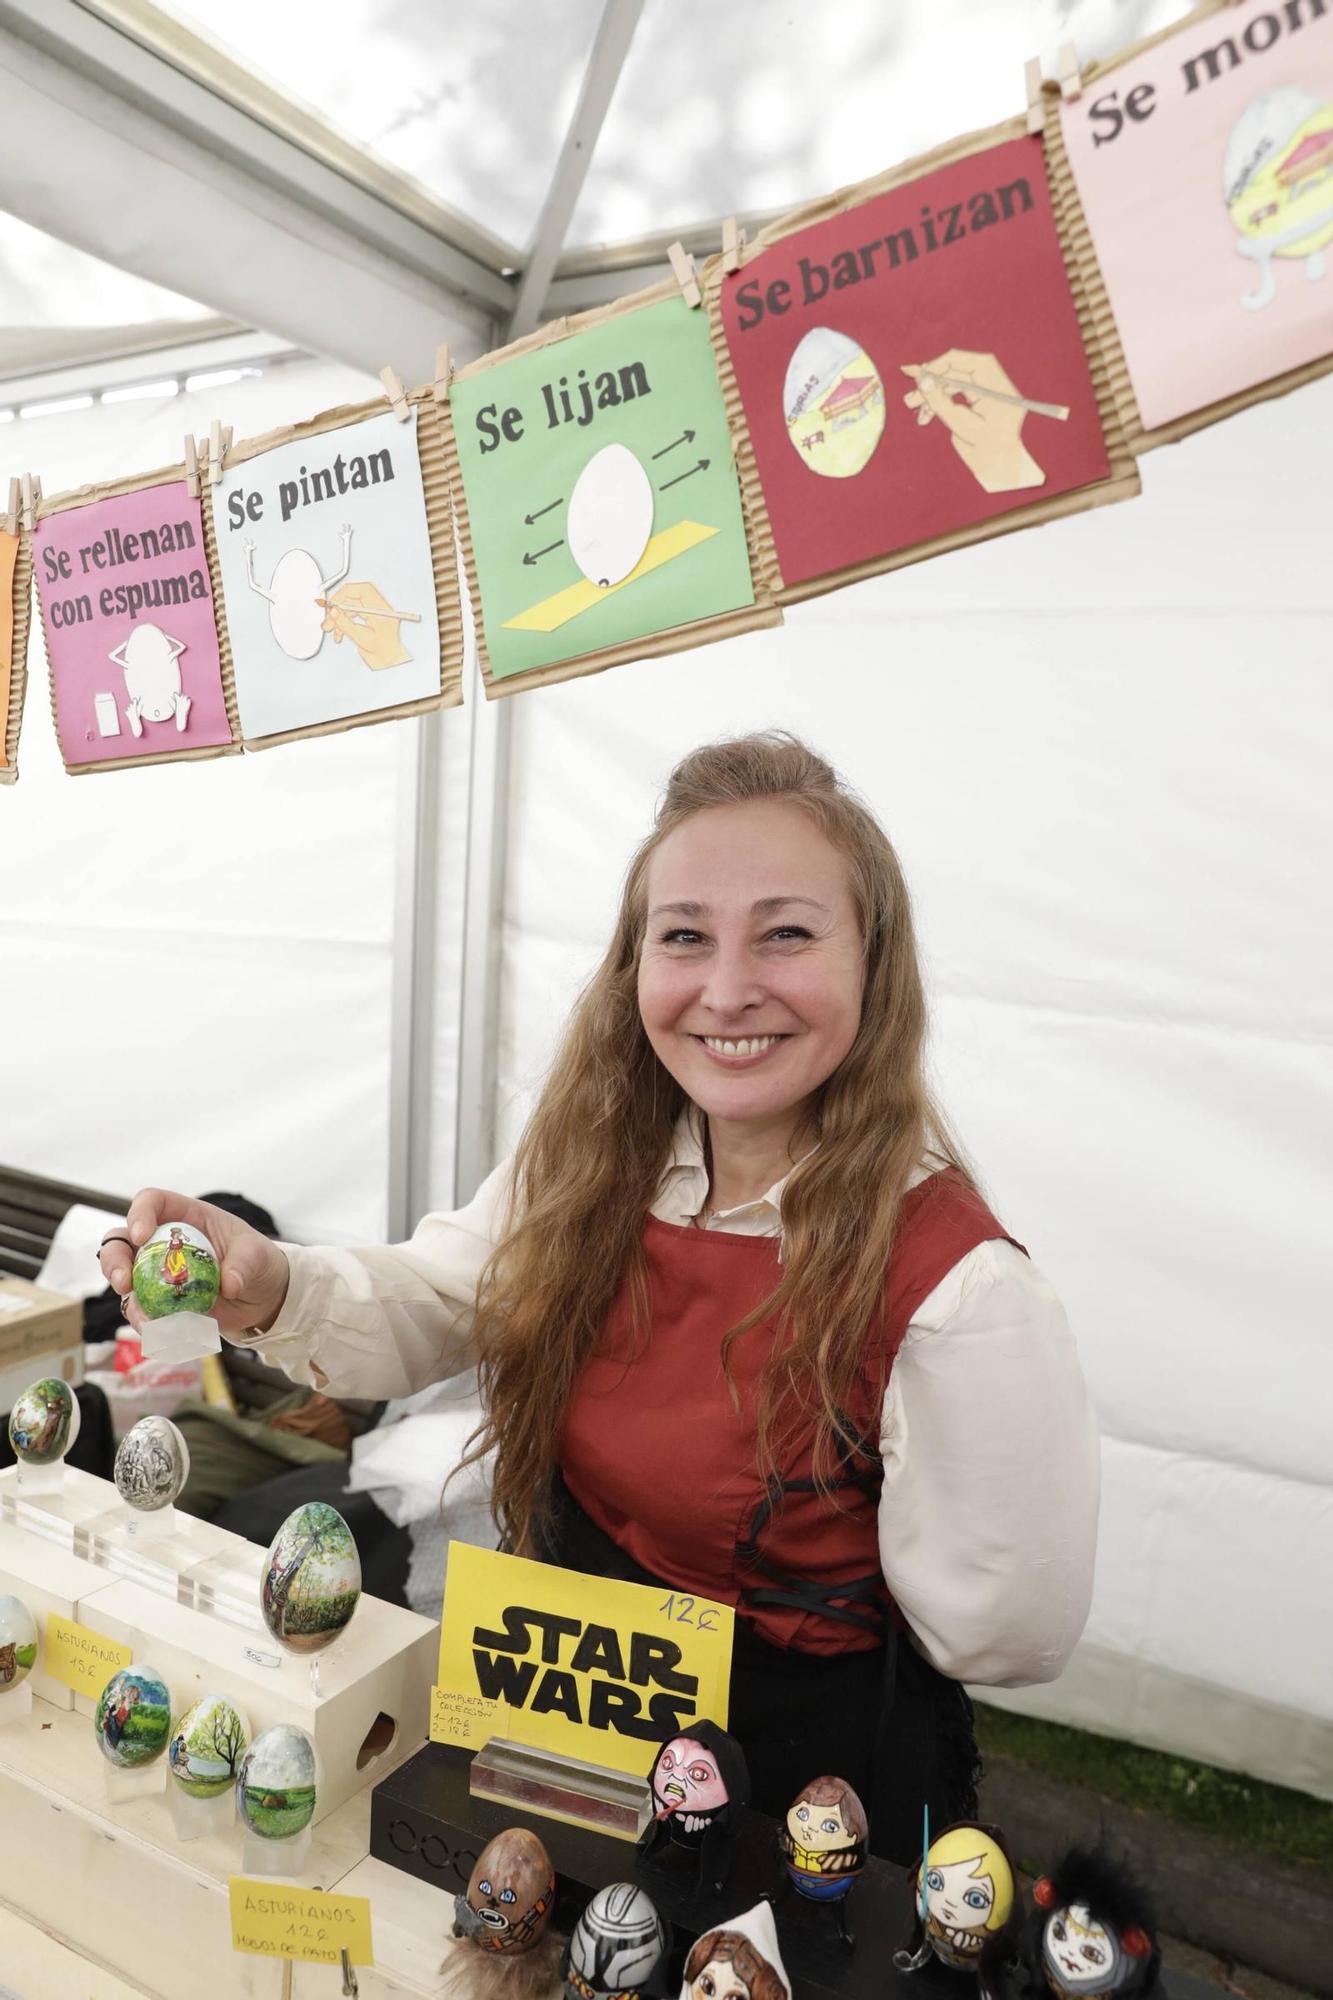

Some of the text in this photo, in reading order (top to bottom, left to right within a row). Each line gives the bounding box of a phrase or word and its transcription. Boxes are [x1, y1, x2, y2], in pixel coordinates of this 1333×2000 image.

[1088, 82, 1157, 149] Se
[735, 176, 1036, 332] Se barnizan
[476, 361, 652, 455] Se lijan
[227, 448, 395, 532] Se pintan
[42, 520, 197, 585] Se rellenan
[50, 569, 210, 630] con espuma
[473, 1606, 698, 1695] STAR
[658, 1593, 721, 1632] 12€
[472, 1648, 696, 1742] WARS
